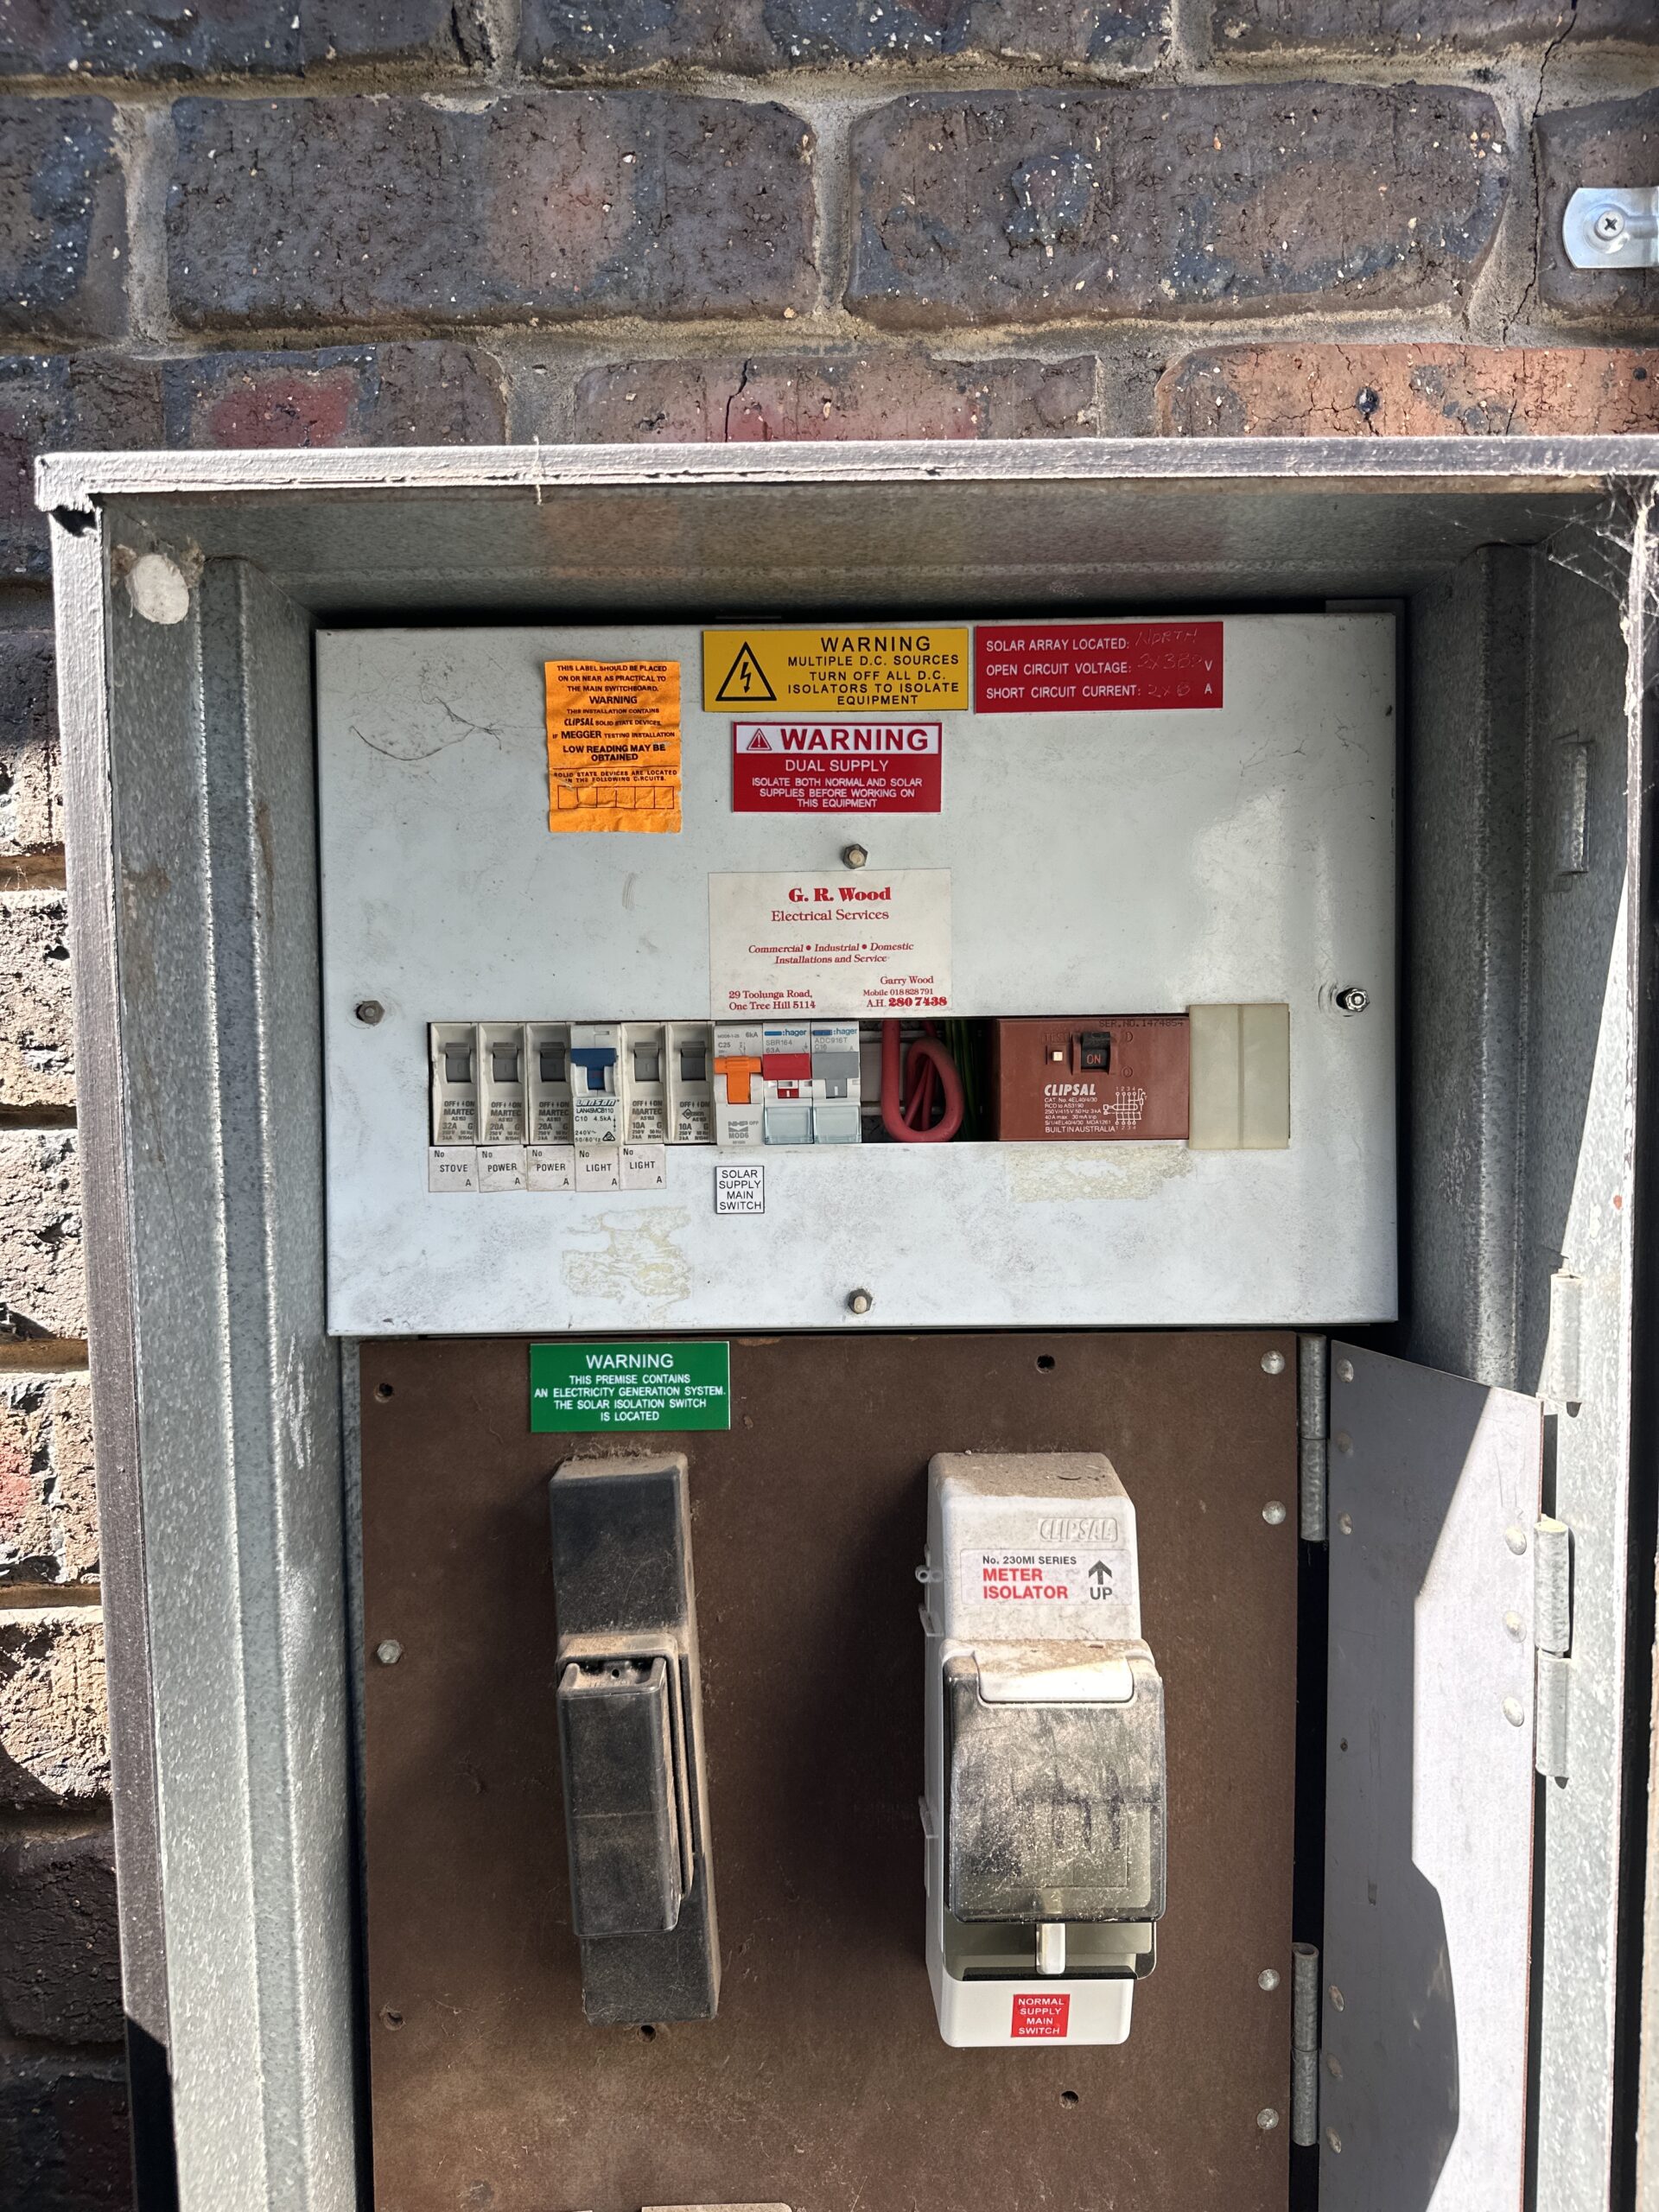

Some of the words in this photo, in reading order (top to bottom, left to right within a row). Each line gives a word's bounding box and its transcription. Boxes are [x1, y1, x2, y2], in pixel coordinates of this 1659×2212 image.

[821, 637, 930, 652] WARNING
[987, 640, 1025, 652] SOLAR
[1029, 639, 1069, 651] ARRAY
[1072, 638, 1129, 650] LOCATED:
[788, 657, 855, 666] MULTIPLE
[860, 656, 887, 666] D.C.
[893, 655, 958, 664] SOURCES
[987, 664, 1018, 676] OPEN
[1024, 663, 1069, 675] CIRCUIT
[1075, 662, 1131, 674] VOLTAGE:
[1205, 660, 1212, 671] V
[810, 671, 848, 681] TURN
[853, 671, 880, 681] OFF
[887, 671, 913, 680] ALL
[918, 670, 946, 680] D.C.
[788, 683, 869, 694] ISOLATORS
[875, 683, 894, 693] TO
[899, 682, 958, 693] ISOLATE
[987, 688, 1025, 699] SHORT
[1031, 687, 1076, 697] CIRCUIT
[1083, 684, 1141, 696] CURRENT:
[1205, 683, 1212, 694] A
[837, 695, 918, 706] EQUIPMENT
[781, 728, 928, 751] WARNING
[786, 760, 825, 772] DUAL
[830, 760, 889, 772] SUPPLY
[753, 778, 792, 786] ISOLATE
[796, 778, 822, 786] BOTH
[825, 778, 864, 786] NORMAL
[866, 778, 887, 786] AND
[891, 777, 922, 786] SOLAR
[760, 789, 804, 798] SUPPLIES
[808, 789, 847, 798] BEFORE
[850, 789, 896, 798] WORKING
[900, 788, 914, 798] ON
[798, 798, 820, 808] THIS
[823, 798, 875, 808] EQUIPMENT
[789, 888, 809, 902] G.
[814, 887, 834, 902] R.
[839, 887, 891, 901] Wood
[772, 911, 832, 921] Electrical
[836, 909, 889, 920] Services
[748, 944, 804, 953] Commercial
[815, 944, 860, 952] Industrial
[775, 956, 833, 964] Installations
[880, 976, 906, 986] Garry
[909, 976, 933, 984] Wood
[742, 990, 785, 1001] Toolunga
[729, 1001, 747, 1010] One
[750, 1001, 771, 1010] Tree
[773, 1001, 791, 1009] Hill
[793, 1001, 816, 1009] 5114
[867, 999, 886, 1007] A.H.
[888, 998, 912, 1007] 280
[915, 997, 947, 1007] 7438
[1086, 1054, 1101, 1064] ON
[1045, 1084, 1096, 1096] CLIPSAL
[440, 1164, 468, 1173] STOVE
[487, 1163, 517, 1172] POWER
[721, 1170, 758, 1179] SOLAR
[719, 1180, 760, 1189] SUPPLY
[720, 1201, 761, 1210] SWITCH
[586, 1353, 674, 1369] WARNING
[569, 1376, 592, 1385] THIS
[596, 1375, 638, 1384] PREMISE
[642, 1374, 690, 1383] CONTAINS
[535, 1389, 548, 1398] AN
[554, 1388, 614, 1397] ELECTRICITY
[619, 1387, 679, 1396] GENERATION
[684, 1386, 726, 1395] SYSTEM.
[554, 1401, 573, 1409] THE
[577, 1400, 610, 1409] SOLAR
[614, 1399, 664, 1408] ISOLATION
[670, 1399, 706, 1408] SWITCH
[601, 1412, 610, 1421] IS
[615, 1411, 659, 1421] LOCATED
[1039, 1519, 1116, 1541] CLIPSAL
[982, 1568, 1043, 1581] METER
[983, 1586, 1068, 1599] ISOLATOR
[1090, 1587, 1112, 1600] UP
